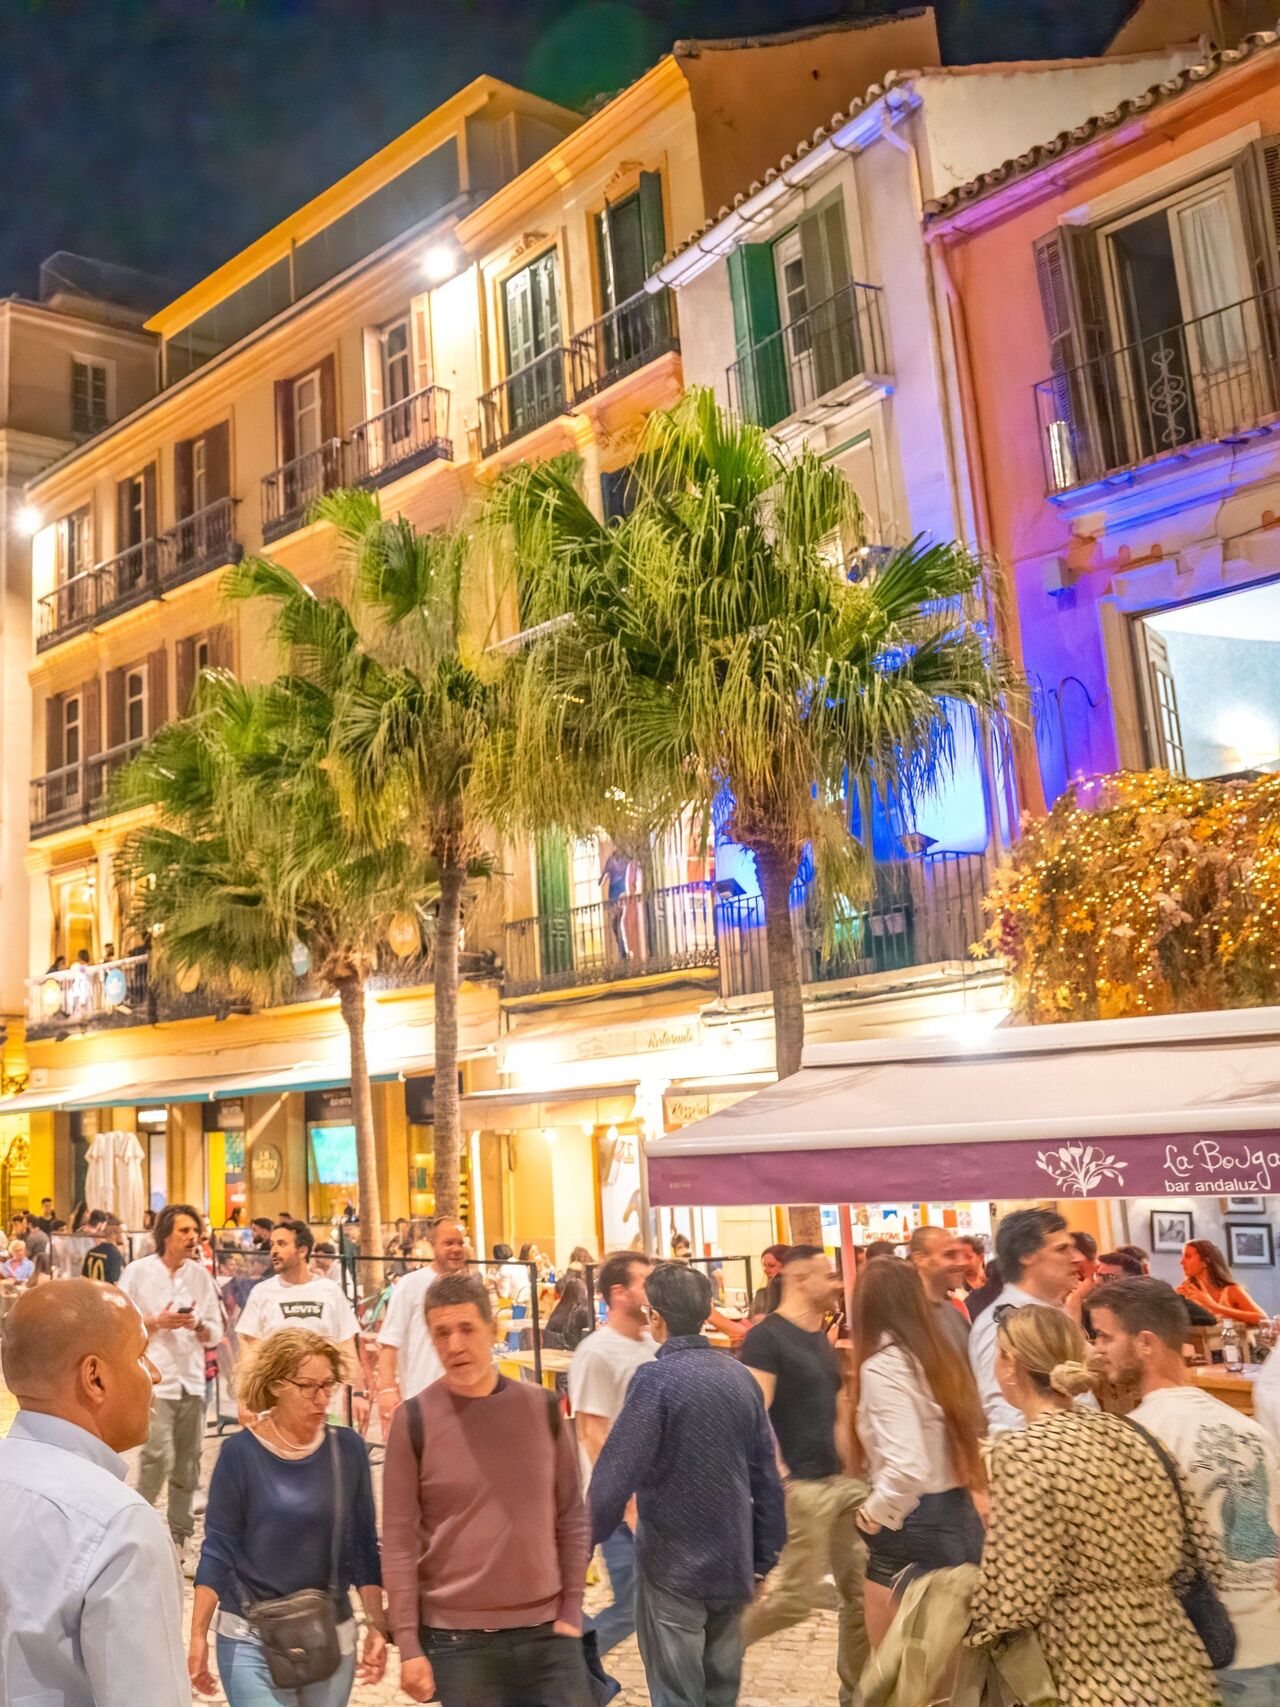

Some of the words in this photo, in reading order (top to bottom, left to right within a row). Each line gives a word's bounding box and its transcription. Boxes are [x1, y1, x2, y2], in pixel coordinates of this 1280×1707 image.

[1163, 1144, 1194, 1177] La
[1164, 1179, 1190, 1192] bar
[1195, 1178, 1259, 1191] andaluz
